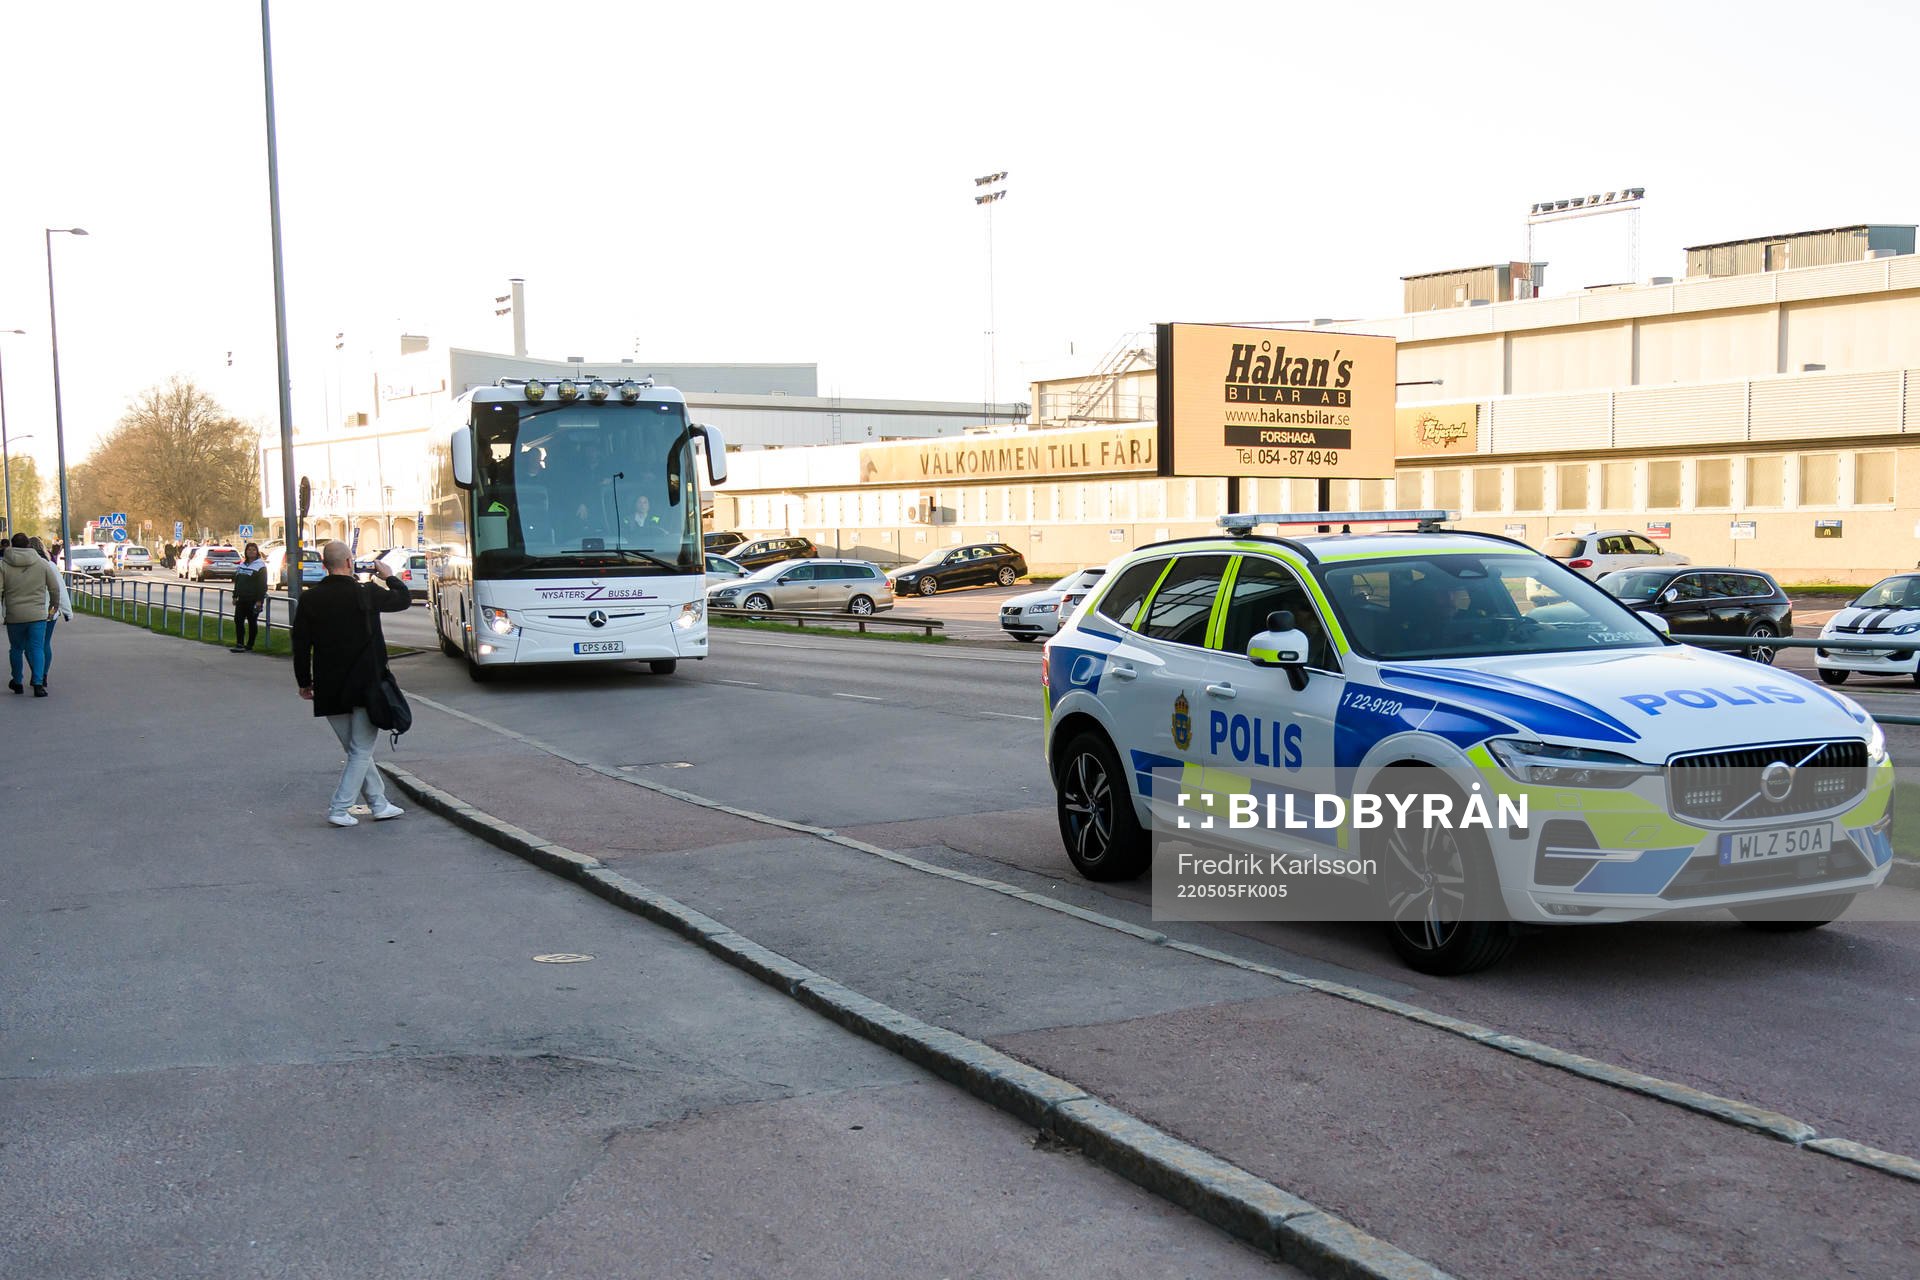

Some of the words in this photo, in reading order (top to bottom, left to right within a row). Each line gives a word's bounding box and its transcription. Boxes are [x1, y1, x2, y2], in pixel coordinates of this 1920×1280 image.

[1225, 340, 1354, 388] Håkan's
[1229, 387, 1301, 403] BILAR
[1321, 391, 1346, 404] AB
[1225, 408, 1350, 425] www.hakansbilar.se
[1260, 431, 1316, 444] FORSHAGA
[920, 447, 1039, 475] VÄLKOMMEN
[1048, 443, 1091, 468] TILL
[1236, 449, 1255, 464] Tel.
[1258, 449, 1280, 464] 054
[1289, 450, 1304, 465] 87
[1306, 451, 1321, 465] 49
[1323, 451, 1338, 465] 49
[608, 590, 630, 598] BUSS
[632, 589, 643, 597] AB
[582, 643, 600, 652] CPS
[601, 643, 619, 651] 682
[1351, 694, 1403, 716] 22-9120
[1620, 685, 1806, 716] POLIS
[1210, 709, 1303, 773] POLIS
[1739, 833, 1779, 859] WLZ
